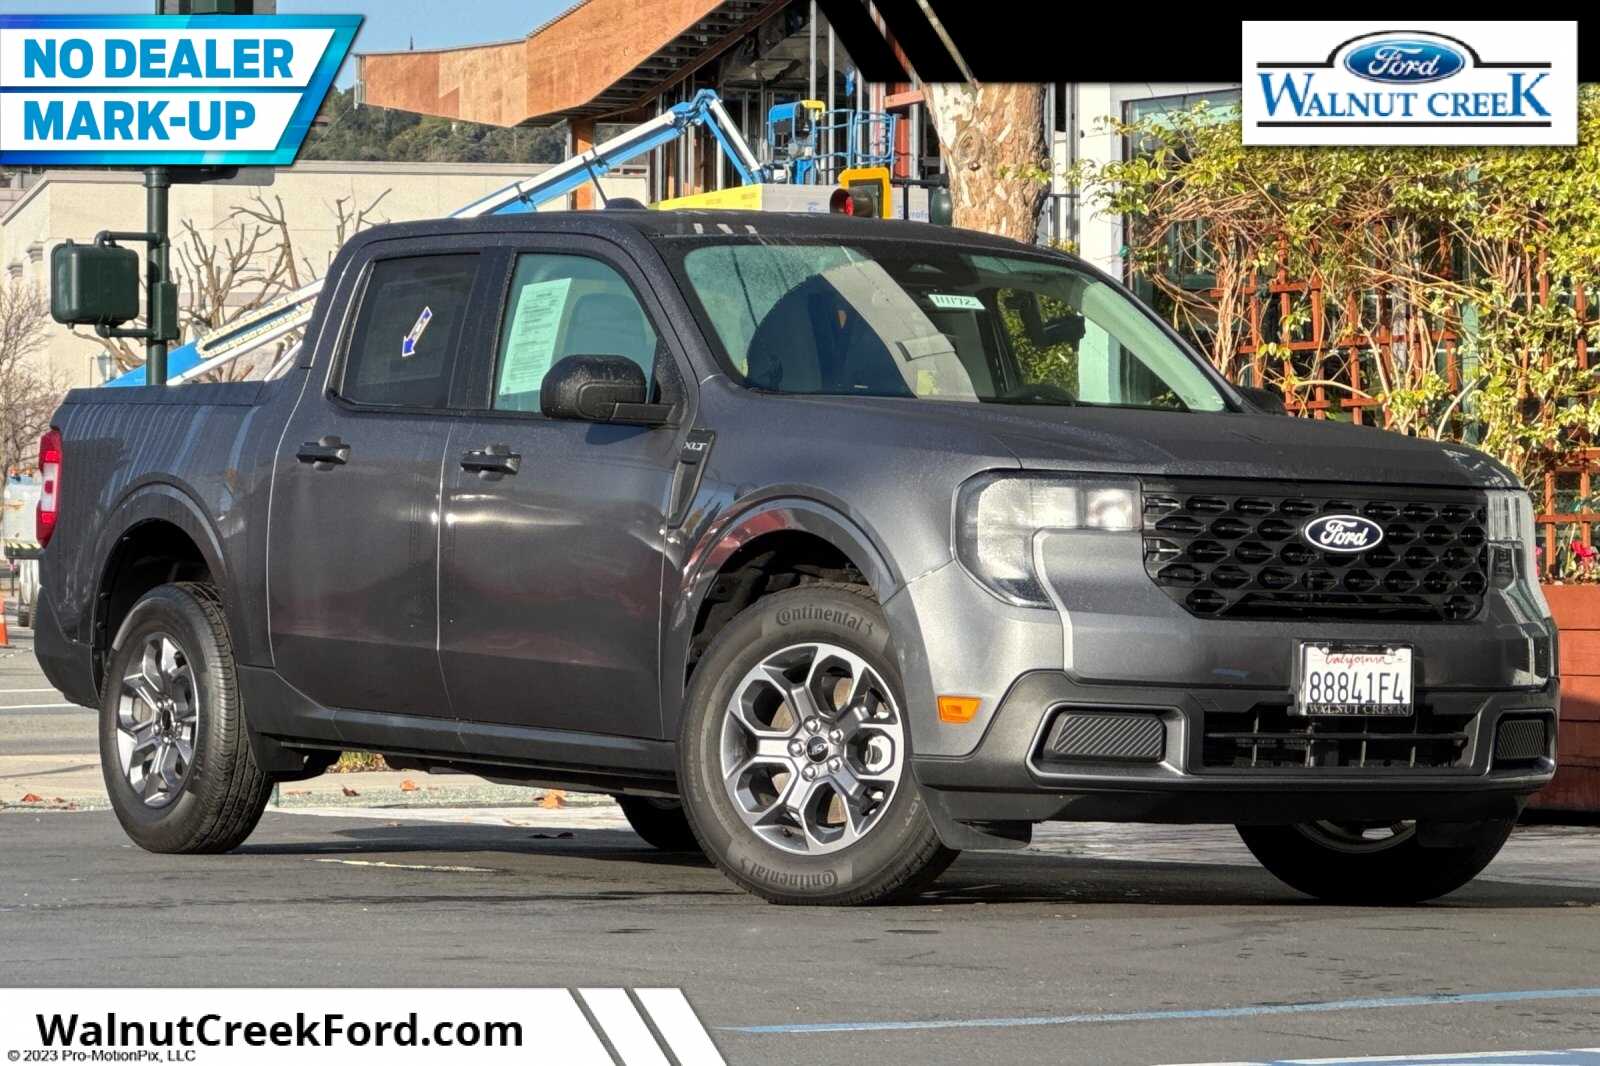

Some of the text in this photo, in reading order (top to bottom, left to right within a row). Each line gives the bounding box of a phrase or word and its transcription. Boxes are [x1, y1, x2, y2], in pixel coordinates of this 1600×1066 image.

[683, 441, 708, 451] XLT
[1320, 519, 1369, 546] Ford
[776, 603, 864, 633] Continental
[1310, 671, 1405, 704] 88841F4
[1308, 703, 1359, 715] WALNUT
